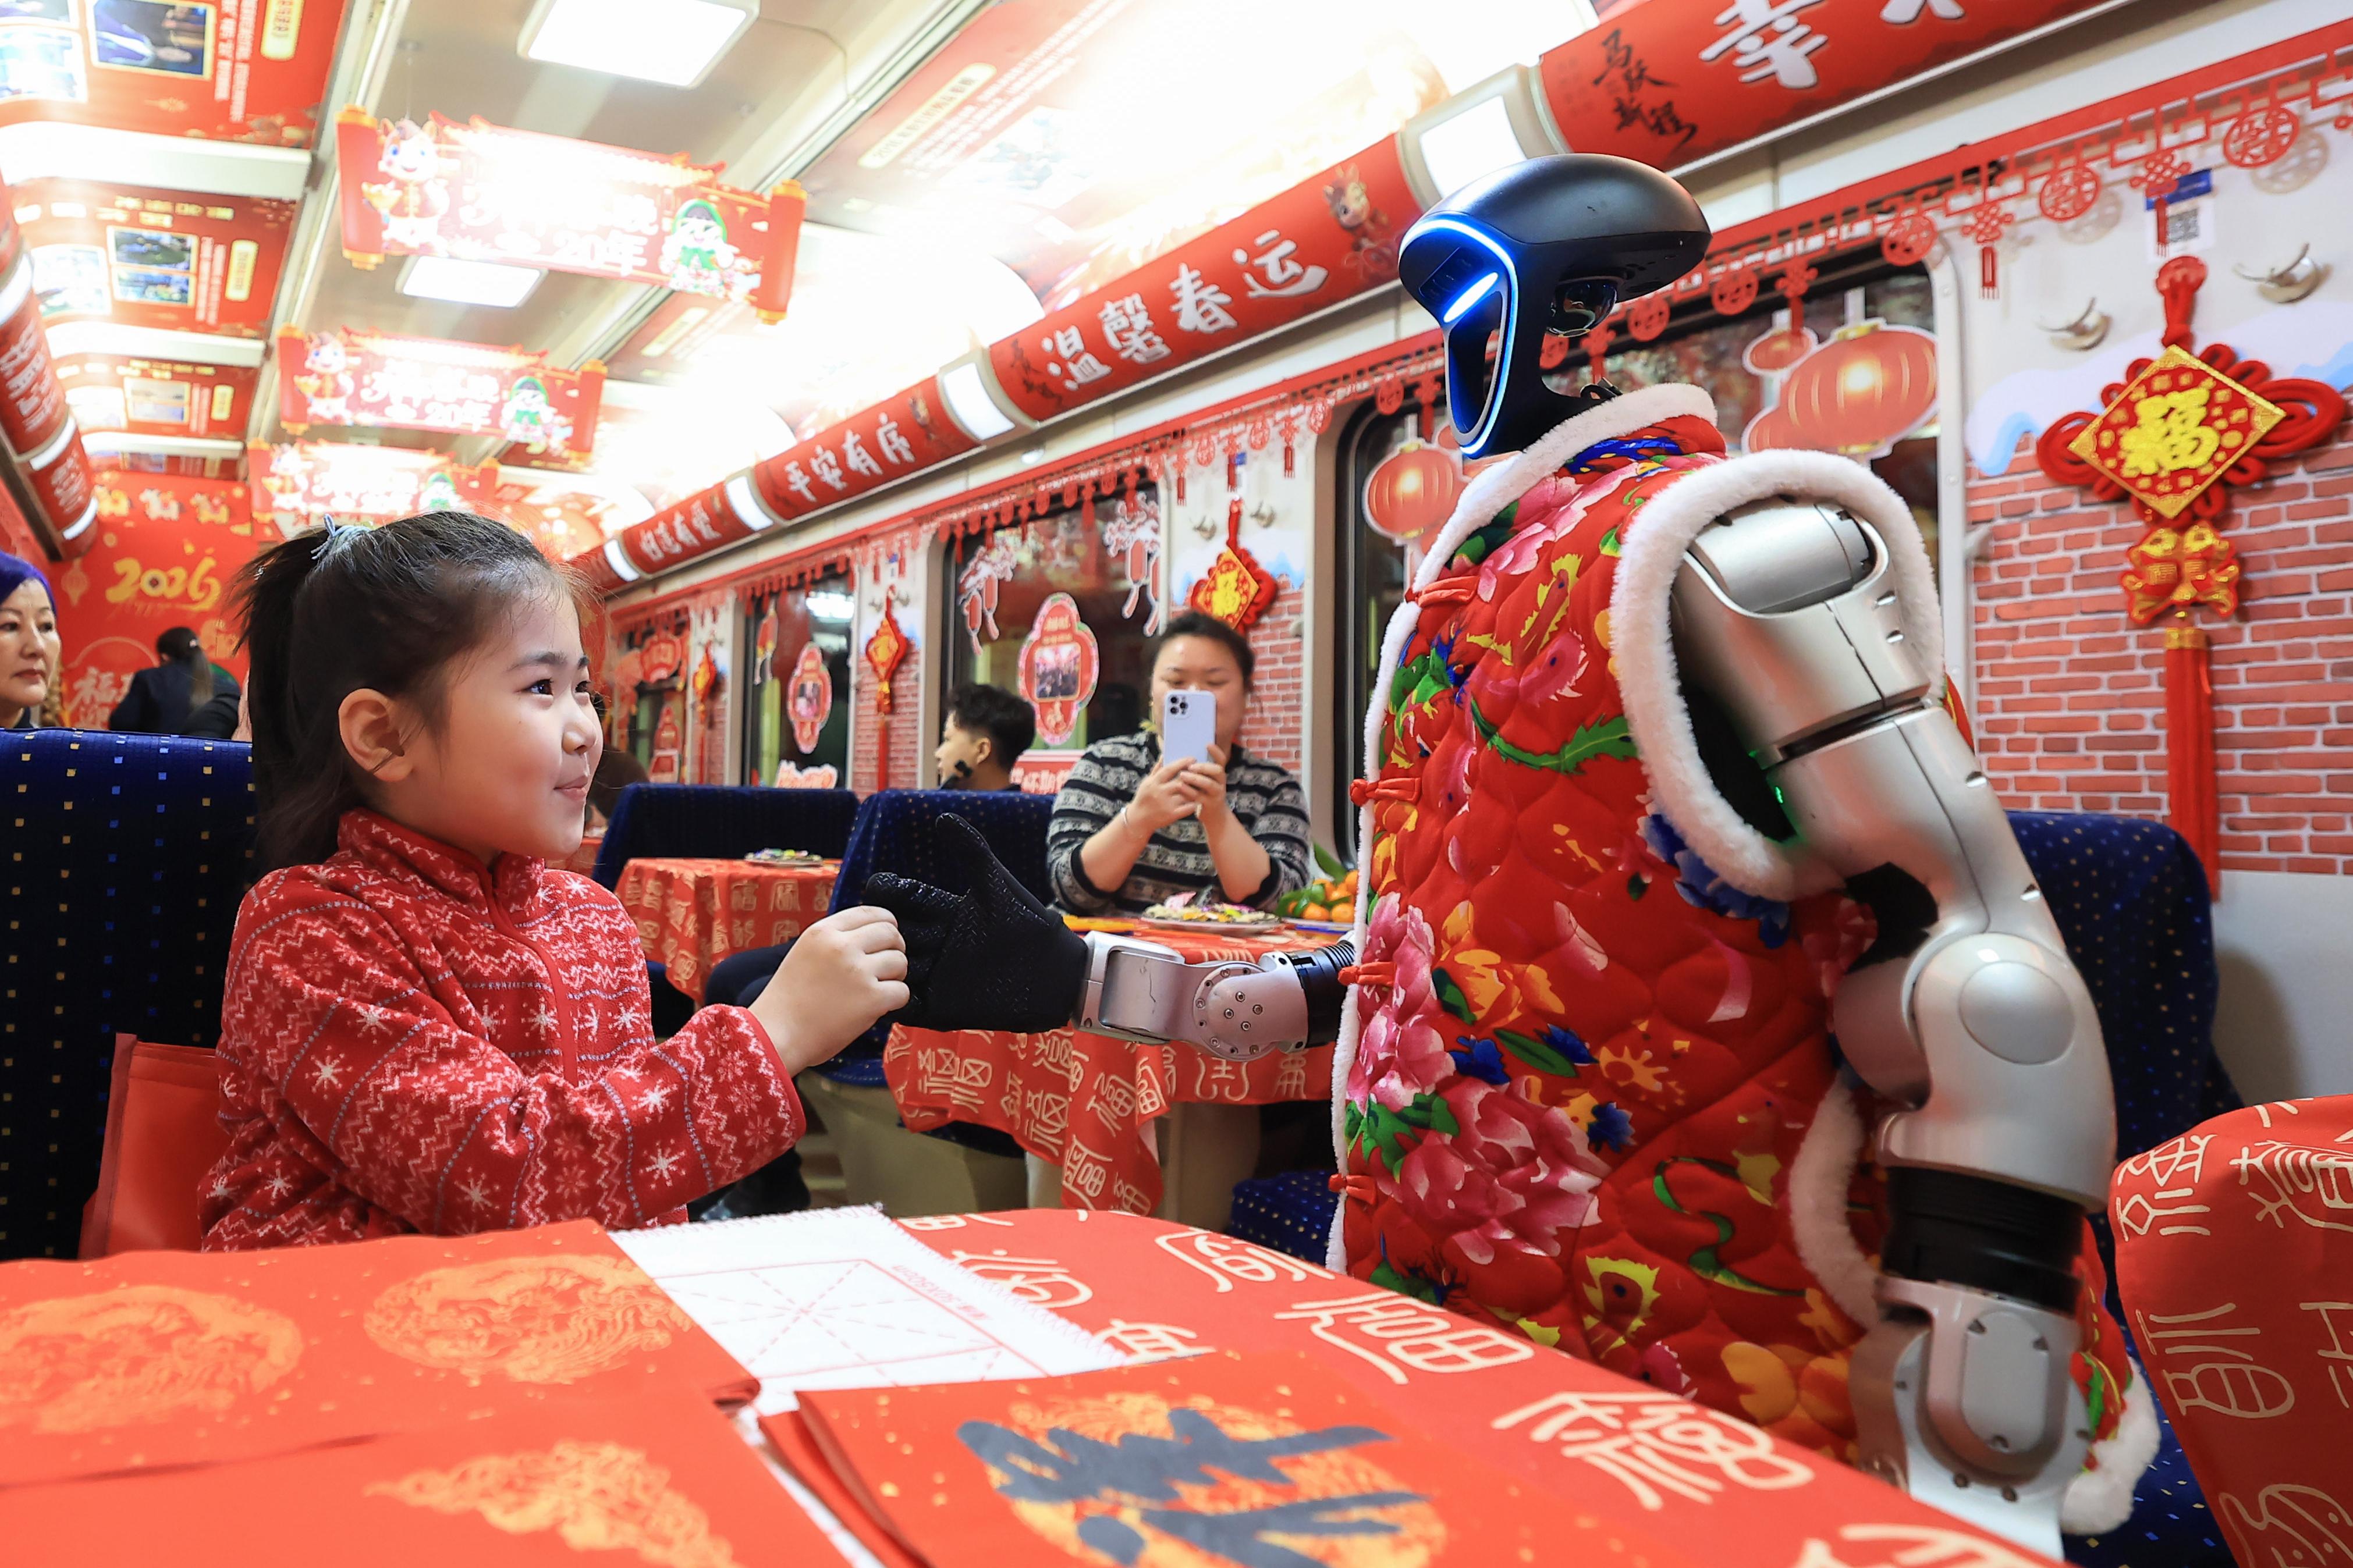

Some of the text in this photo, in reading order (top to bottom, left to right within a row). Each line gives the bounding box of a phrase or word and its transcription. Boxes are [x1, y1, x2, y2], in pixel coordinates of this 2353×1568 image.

[1041, 229, 1329, 392] 温馨春运
[784, 411, 915, 502] 平安有序
[2120, 382, 2221, 476] 福
[105, 556, 222, 611] 2026
